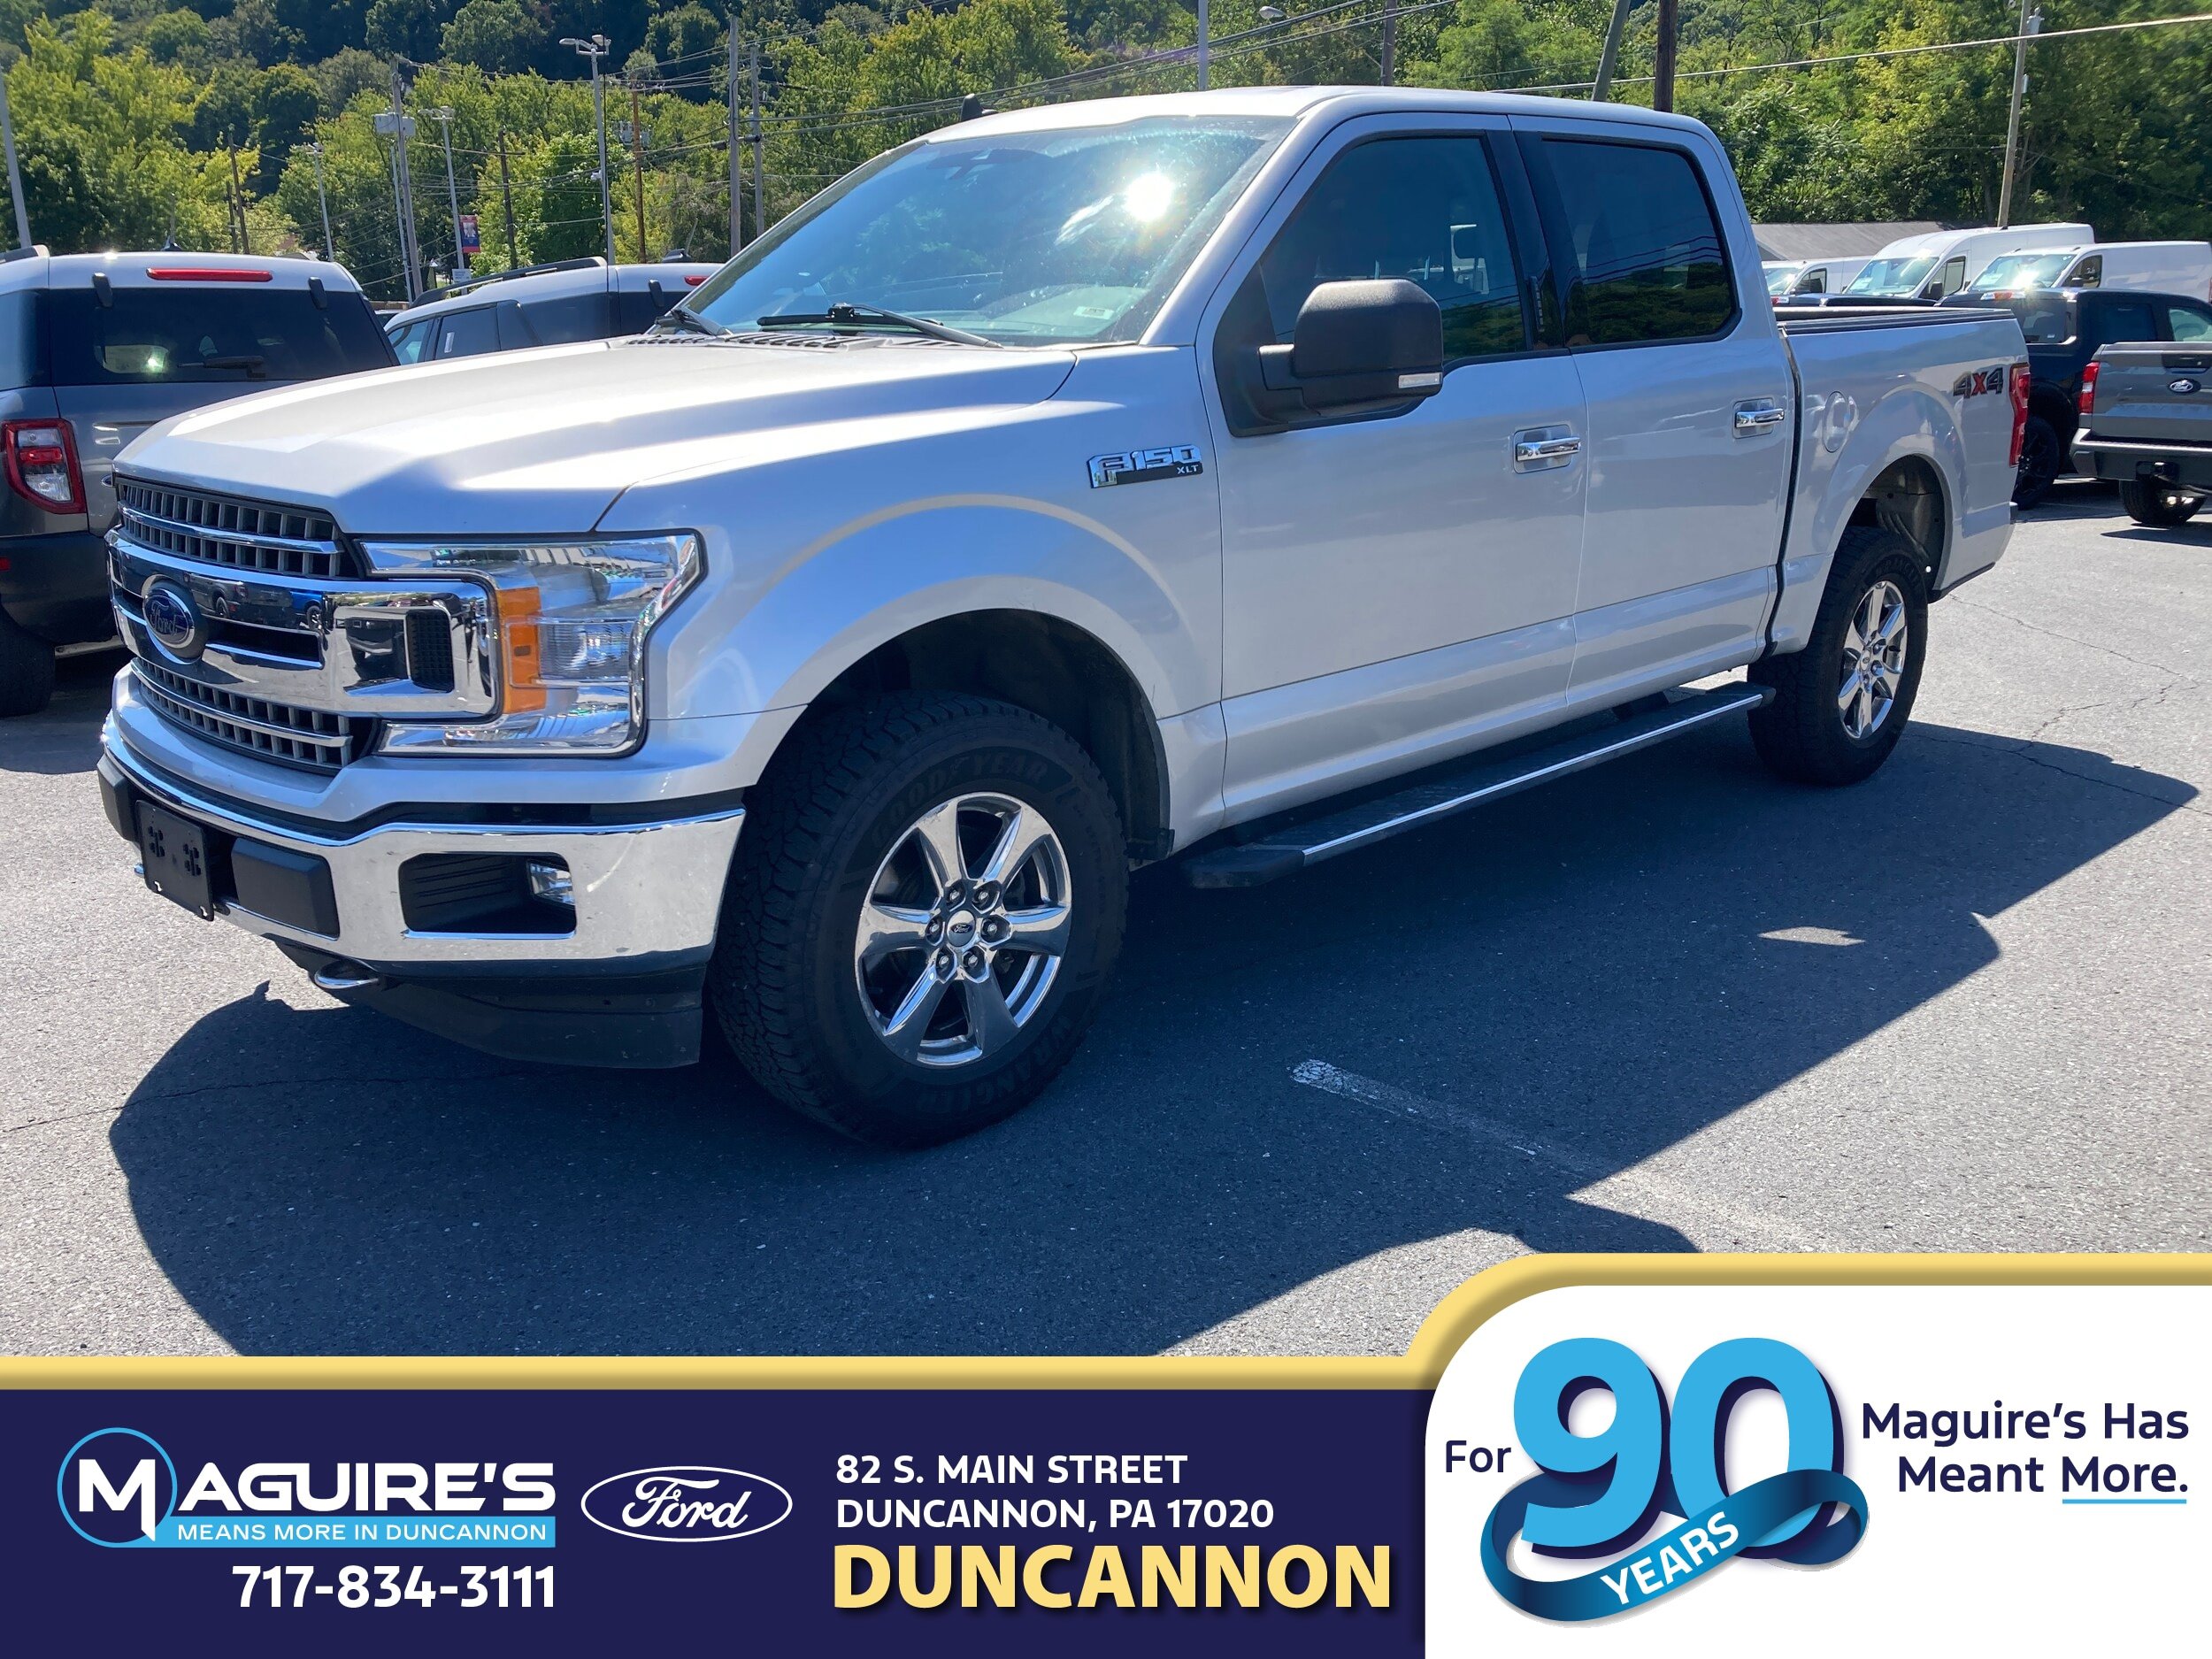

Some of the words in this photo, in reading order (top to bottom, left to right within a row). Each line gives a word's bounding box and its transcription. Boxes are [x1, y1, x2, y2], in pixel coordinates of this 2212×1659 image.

[1177, 465, 1199, 474] XLT
[149, 600, 179, 637] Ford
[872, 750, 1048, 849] GOODYEAR
[953, 923, 972, 933] Ford
